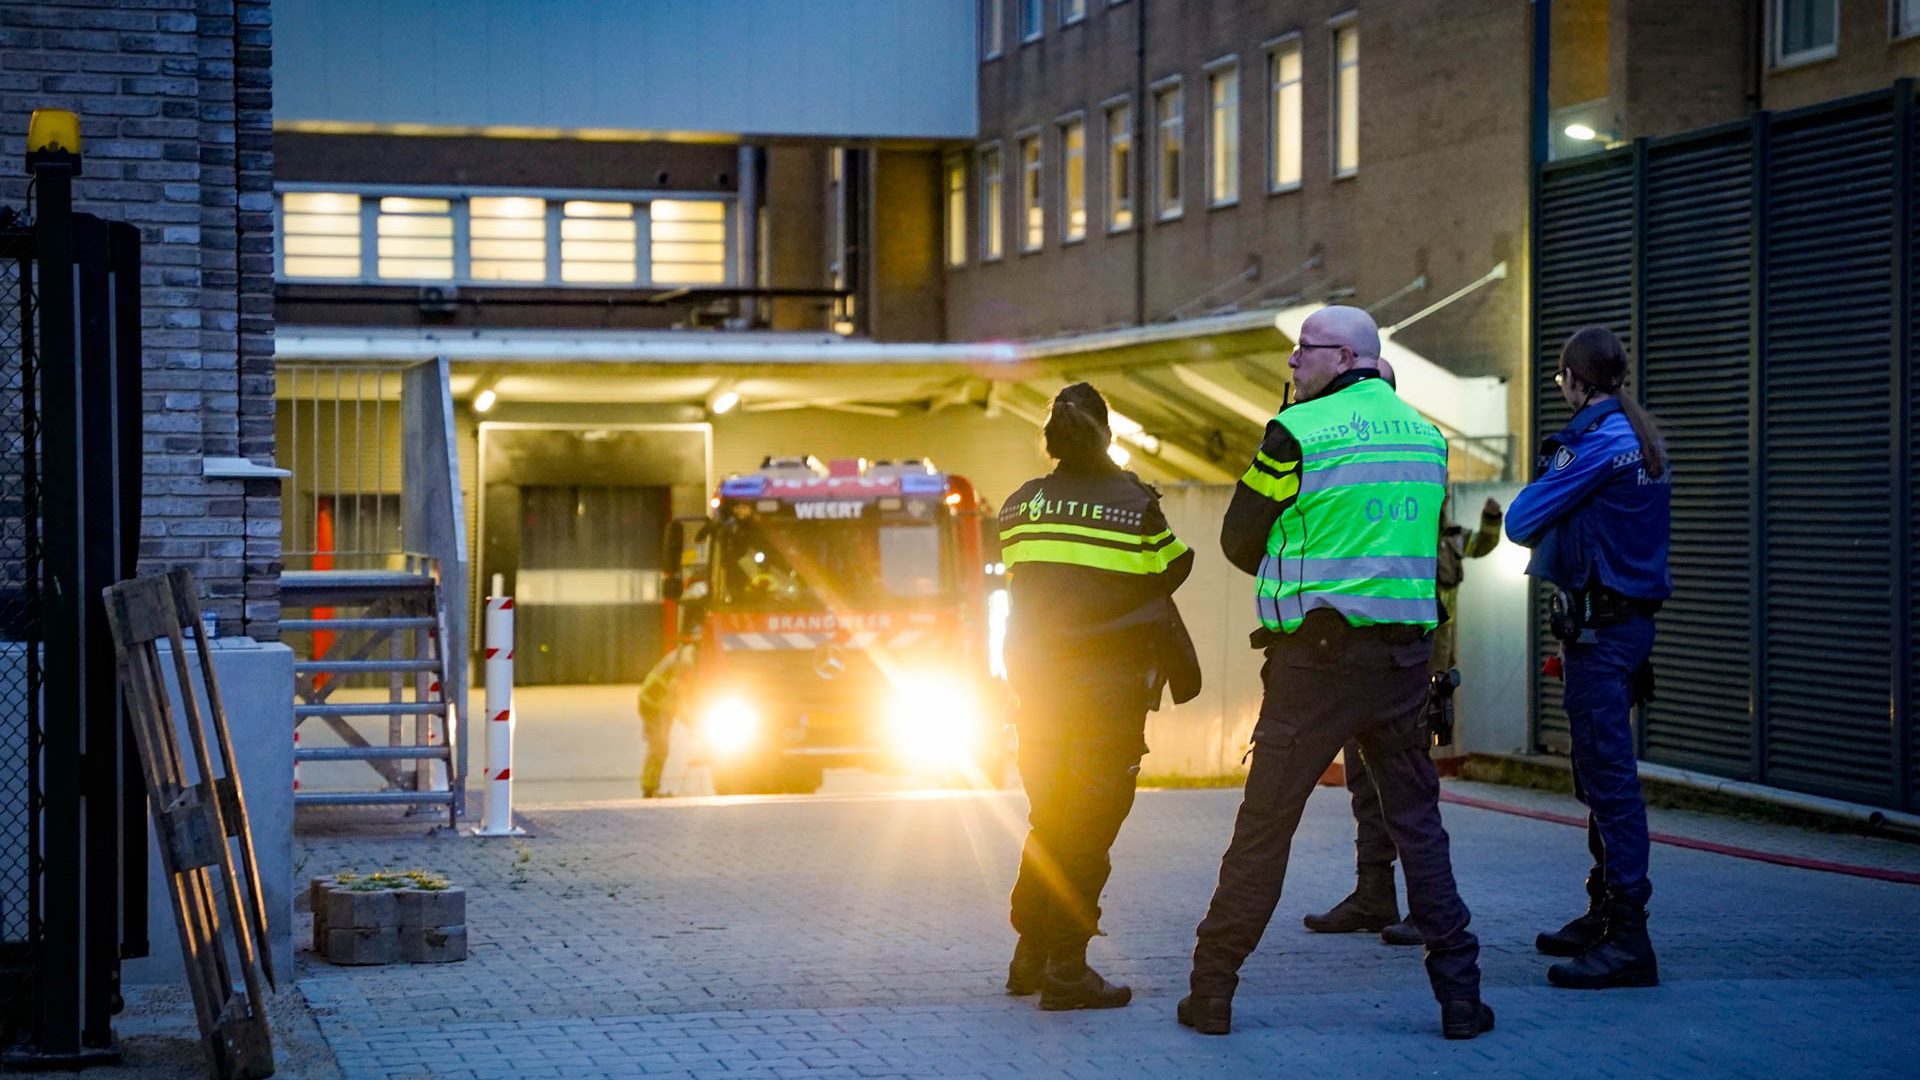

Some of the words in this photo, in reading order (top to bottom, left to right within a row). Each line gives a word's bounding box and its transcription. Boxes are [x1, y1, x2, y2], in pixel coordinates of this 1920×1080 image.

[1338, 417, 1421, 441] POLITIE
[794, 501, 863, 519] WEERT
[1019, 496, 1104, 521] POLITIE
[1365, 497, 1419, 522] OvD
